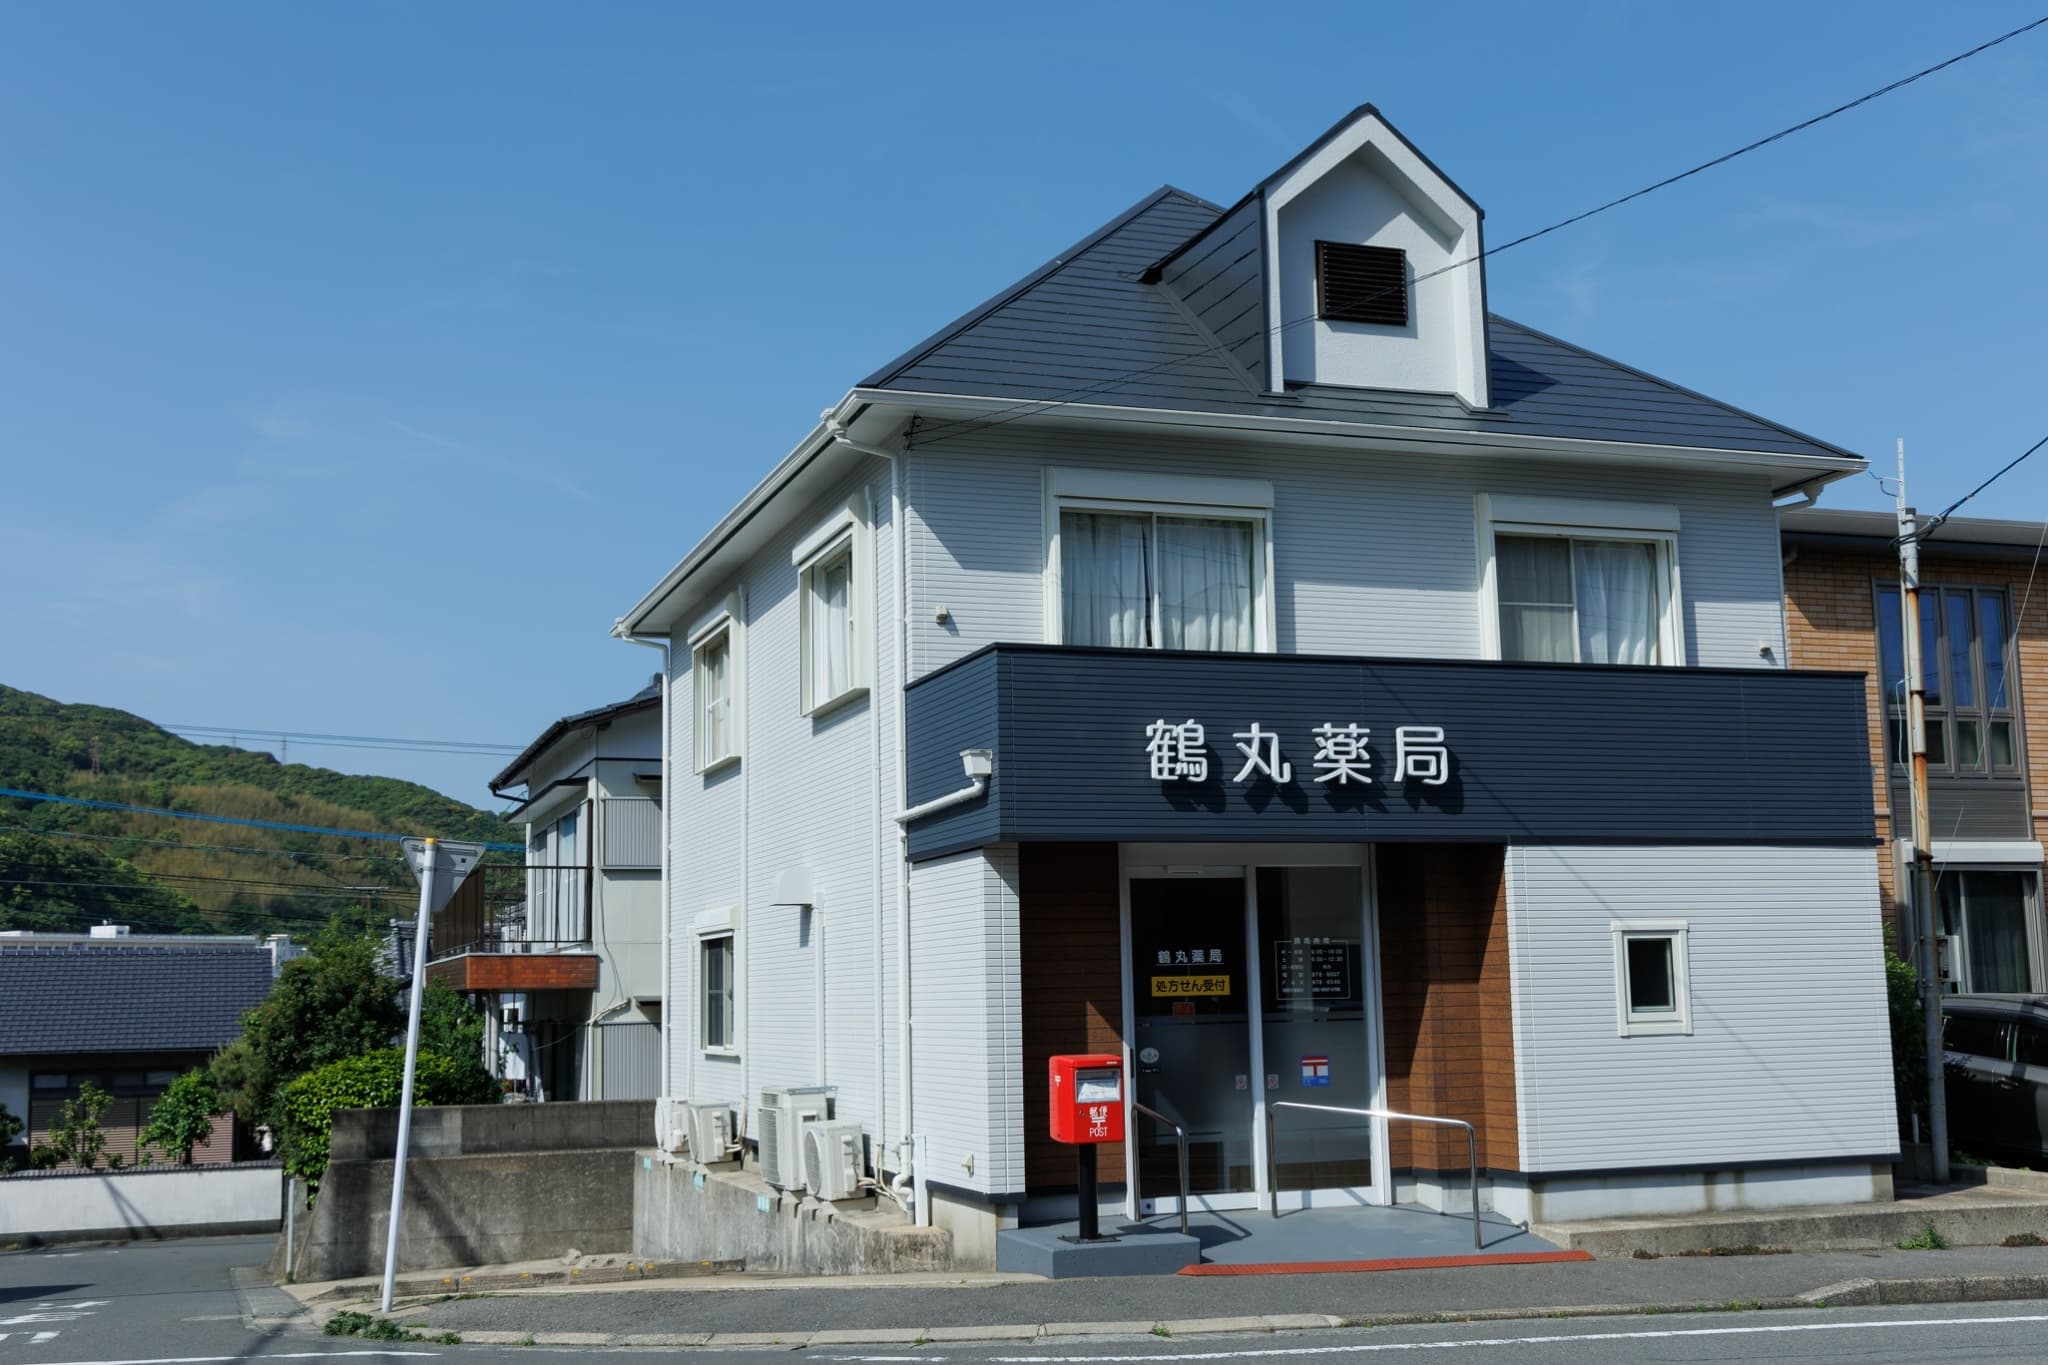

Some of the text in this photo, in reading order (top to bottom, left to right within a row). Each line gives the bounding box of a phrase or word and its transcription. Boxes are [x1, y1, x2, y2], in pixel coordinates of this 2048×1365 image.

[1145, 718, 1449, 785] 鶴丸薬局
[1157, 948, 1222, 964] 鶴丸薬局
[1155, 978, 1225, 993] 処方せん受付
[1089, 1127, 1108, 1137] POST
